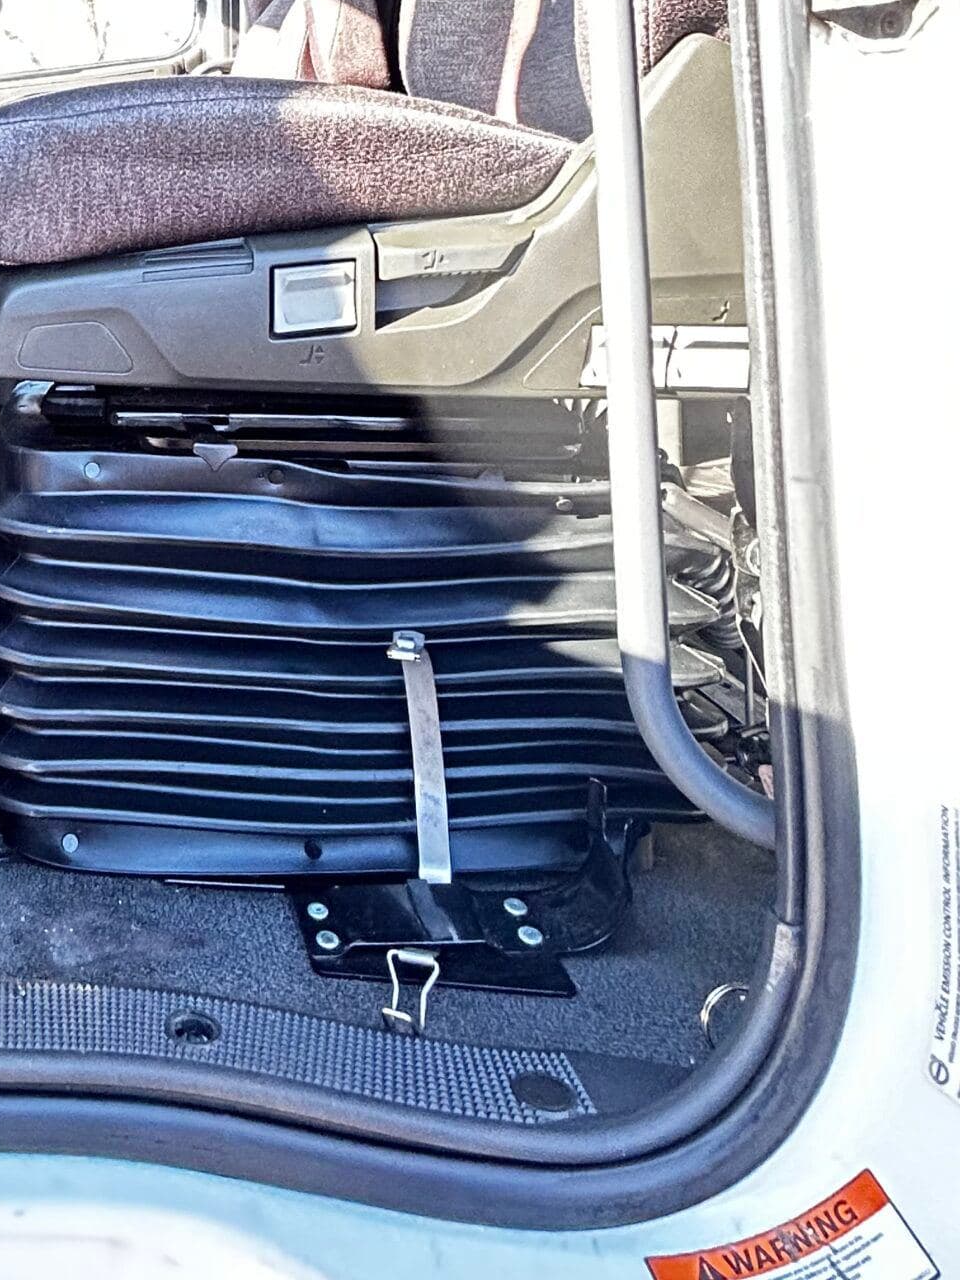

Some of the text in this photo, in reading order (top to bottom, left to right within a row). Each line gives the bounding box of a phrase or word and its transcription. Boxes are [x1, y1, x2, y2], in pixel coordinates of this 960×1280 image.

[934, 804, 952, 1041] VEHICLE EMISSION CONTROL INFORMATION
